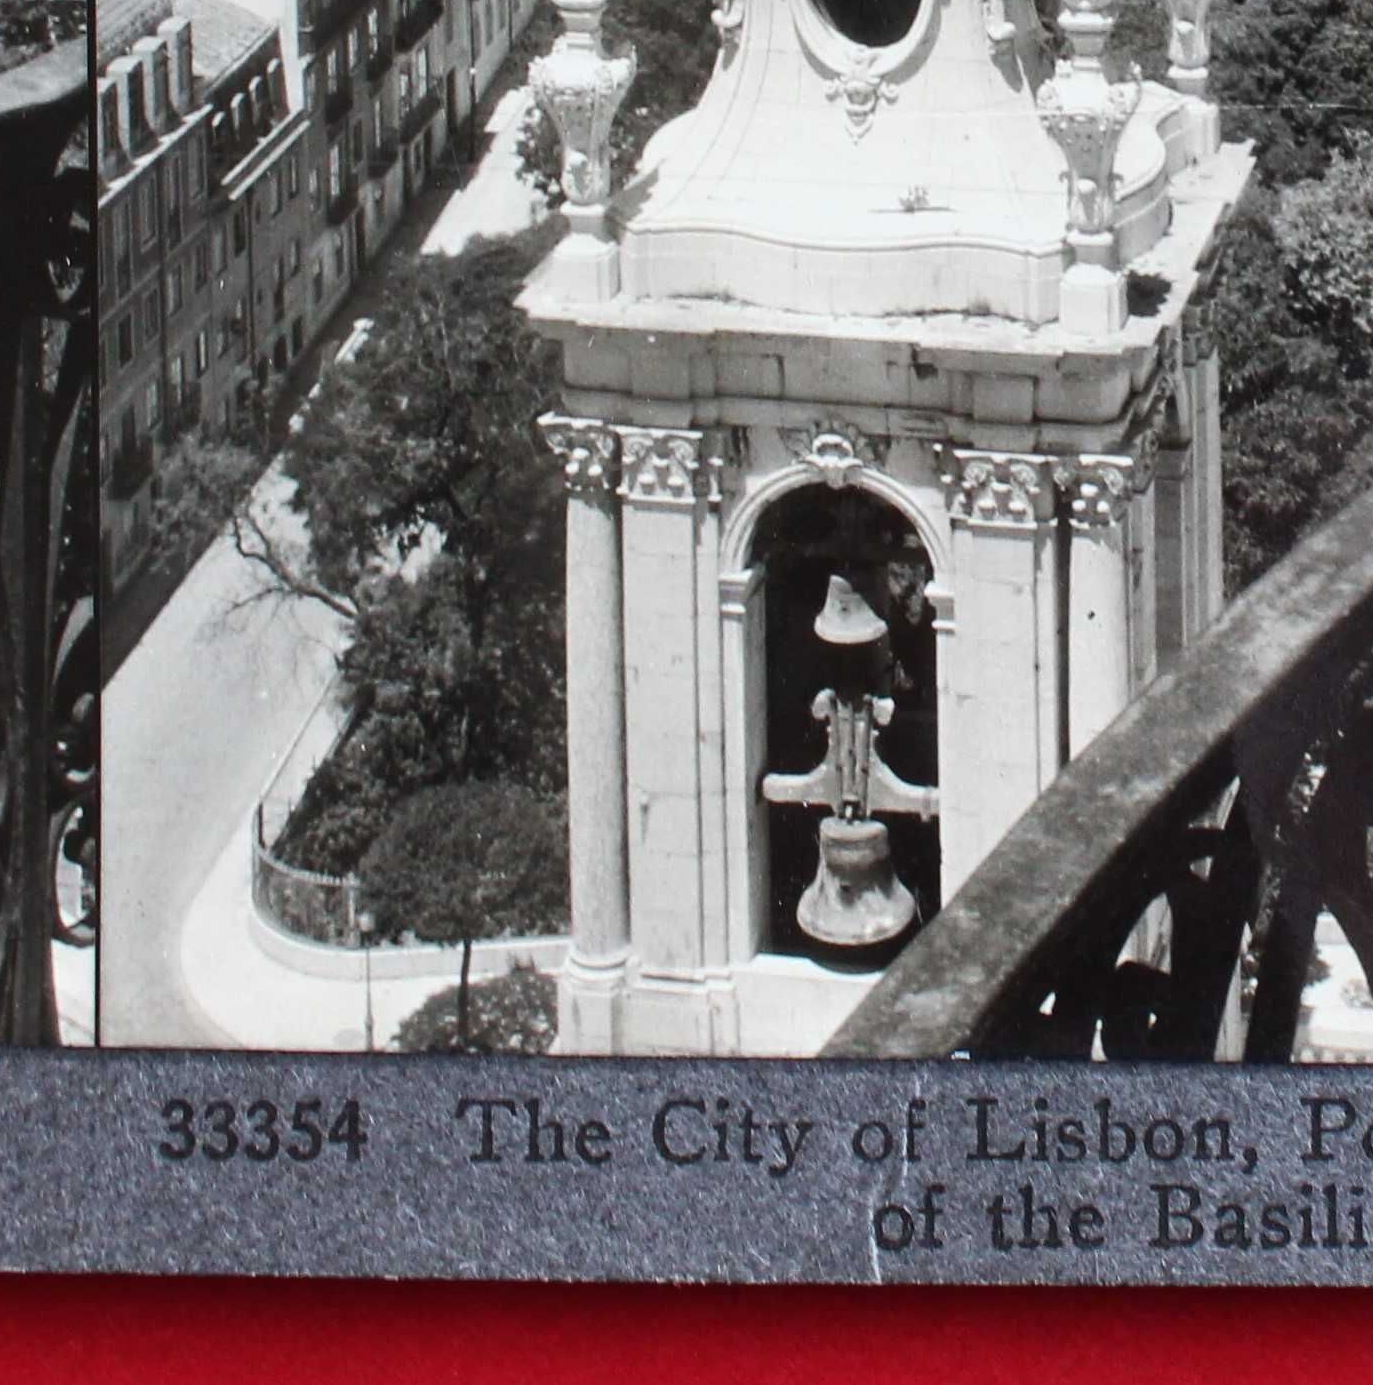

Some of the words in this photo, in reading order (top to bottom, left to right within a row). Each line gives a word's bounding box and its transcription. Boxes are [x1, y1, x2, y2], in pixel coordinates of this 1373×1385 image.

[159, 1096, 368, 1164] 33354
[455, 1097, 612, 1167] The
[653, 1097, 814, 1180] City
[853, 1099, 927, 1165] of
[967, 1096, 1258, 1175] Lisbon,
[874, 1183, 947, 1254] of
[986, 1183, 1104, 1252] the
